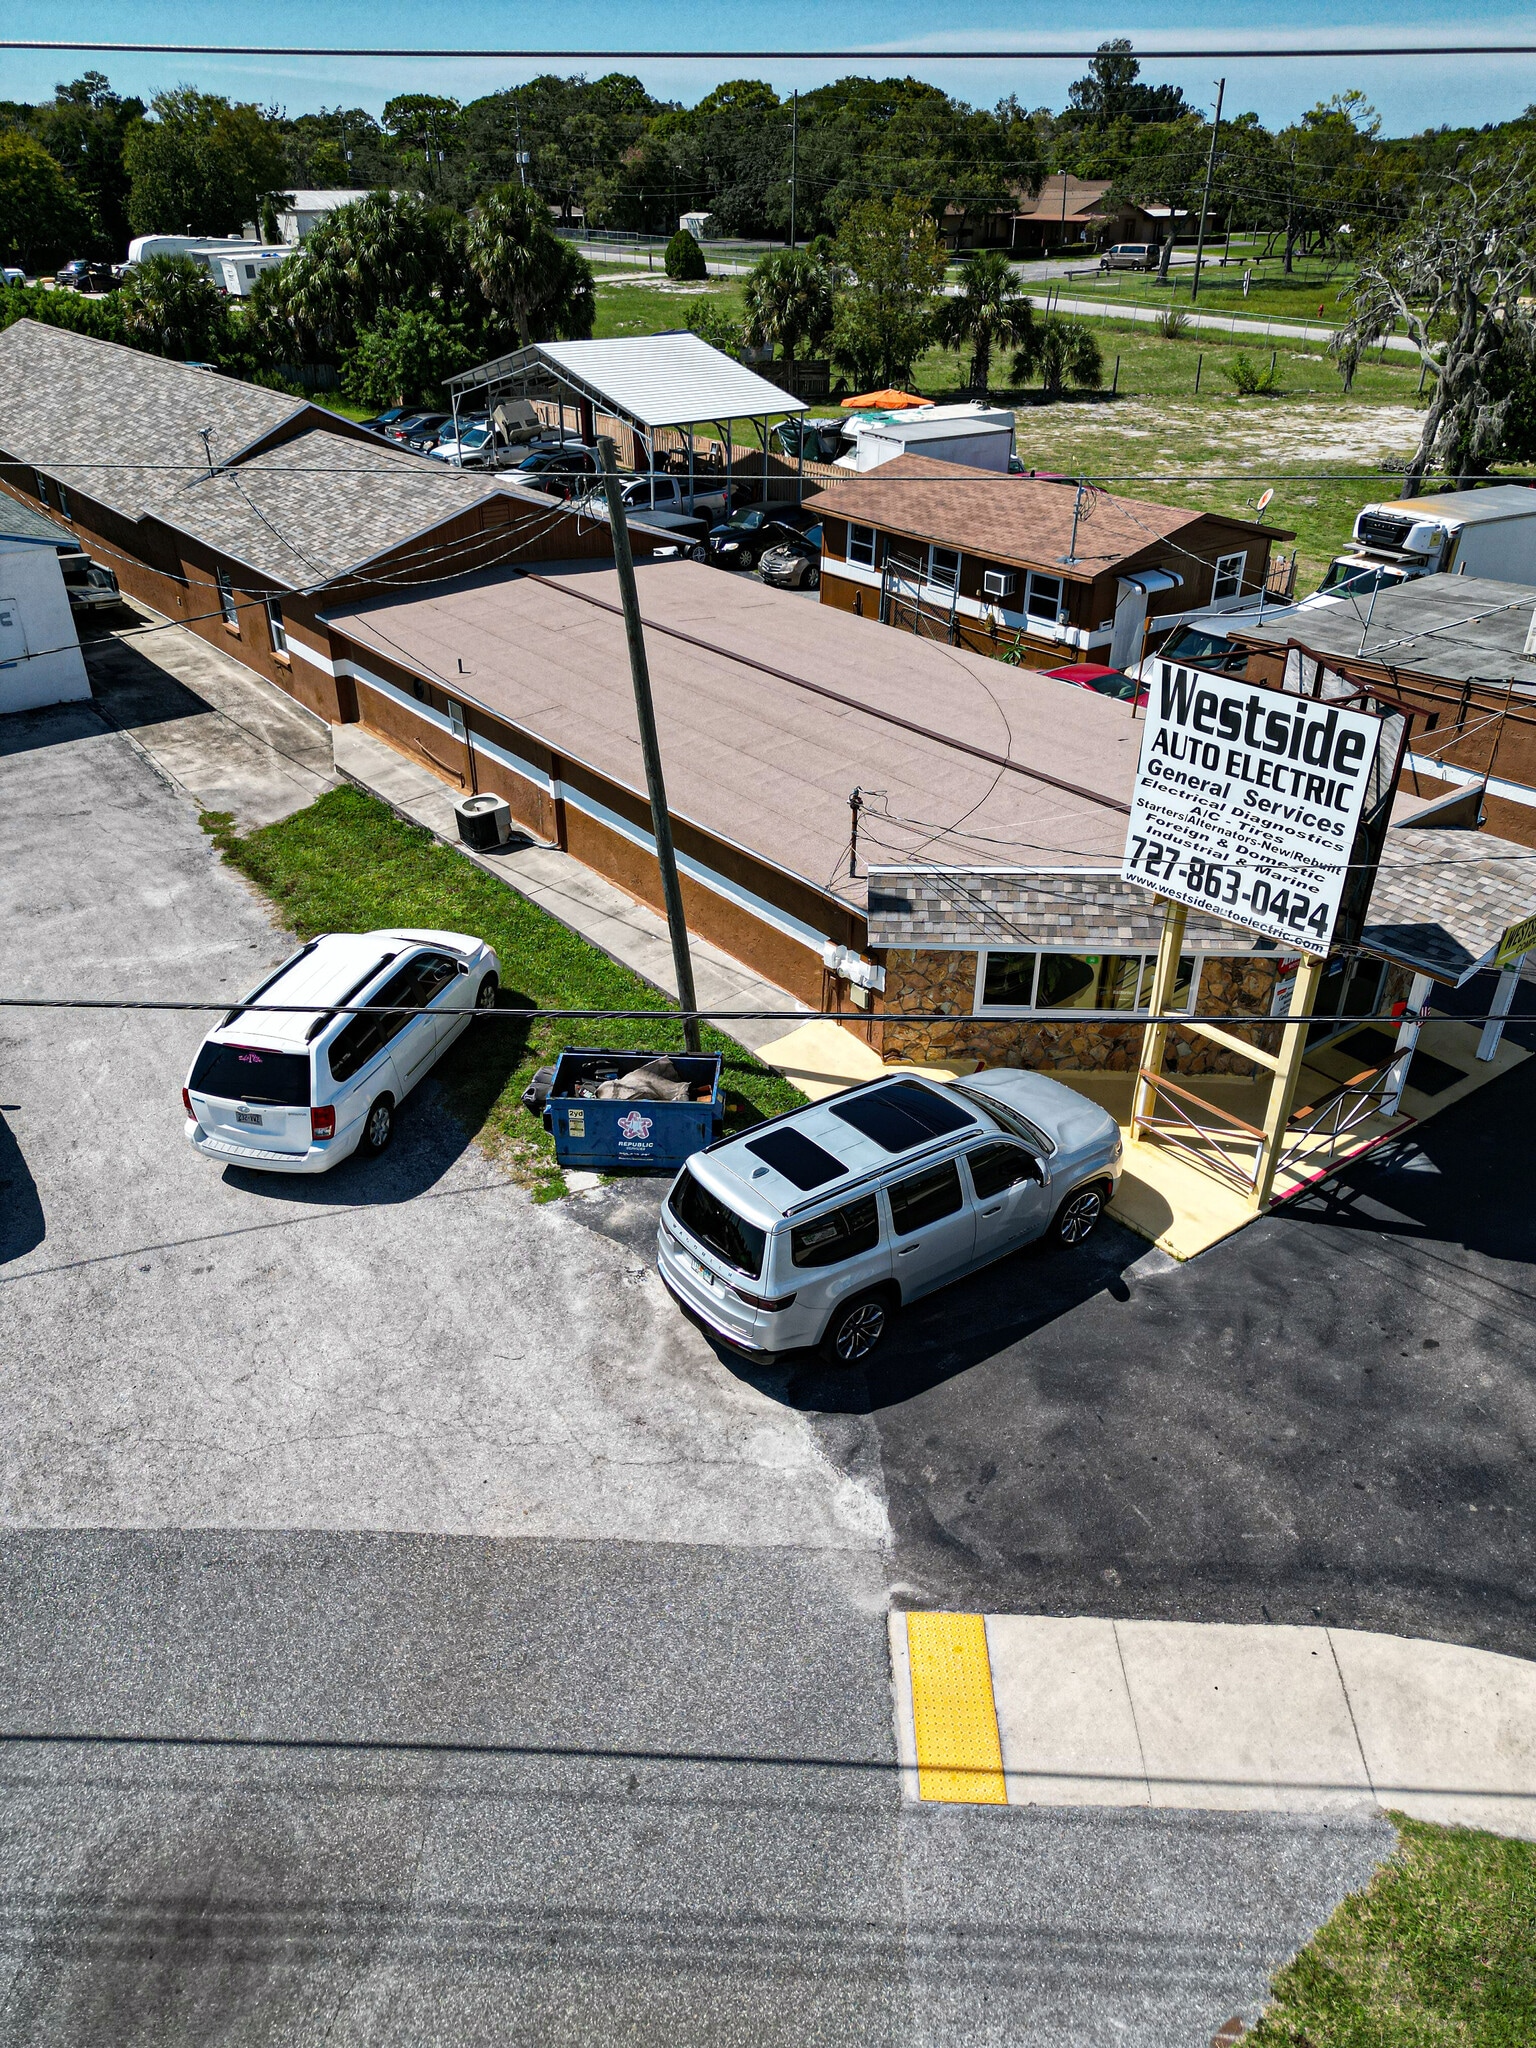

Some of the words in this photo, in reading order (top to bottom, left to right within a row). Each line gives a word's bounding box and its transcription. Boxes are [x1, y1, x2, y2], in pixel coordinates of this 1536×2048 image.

[1160, 663, 1366, 778] Westside
[1147, 758, 1231, 799] General
[1243, 788, 1346, 837] Services
[1151, 727, 1221, 772] AUTO
[1225, 749, 1354, 814] ELECTRIC
[1140, 777, 1226, 811] Electrical
[1231, 807, 1345, 852] Diagnostics
[1145, 812, 1210, 842] Foreign
[1216, 838, 1228, 849] &
[1235, 844, 1326, 883] Domestic
[1190, 806, 1221, 821] A/C
[1239, 821, 1284, 844] Tires
[1129, 835, 1329, 939] 727-863-0424
[1146, 825, 1230, 861] Industrial
[1254, 865, 1320, 894] Marine
[1121, 872, 1324, 953] www.westsideautoelectric.com
[569, 1110, 584, 1118] 2yd
